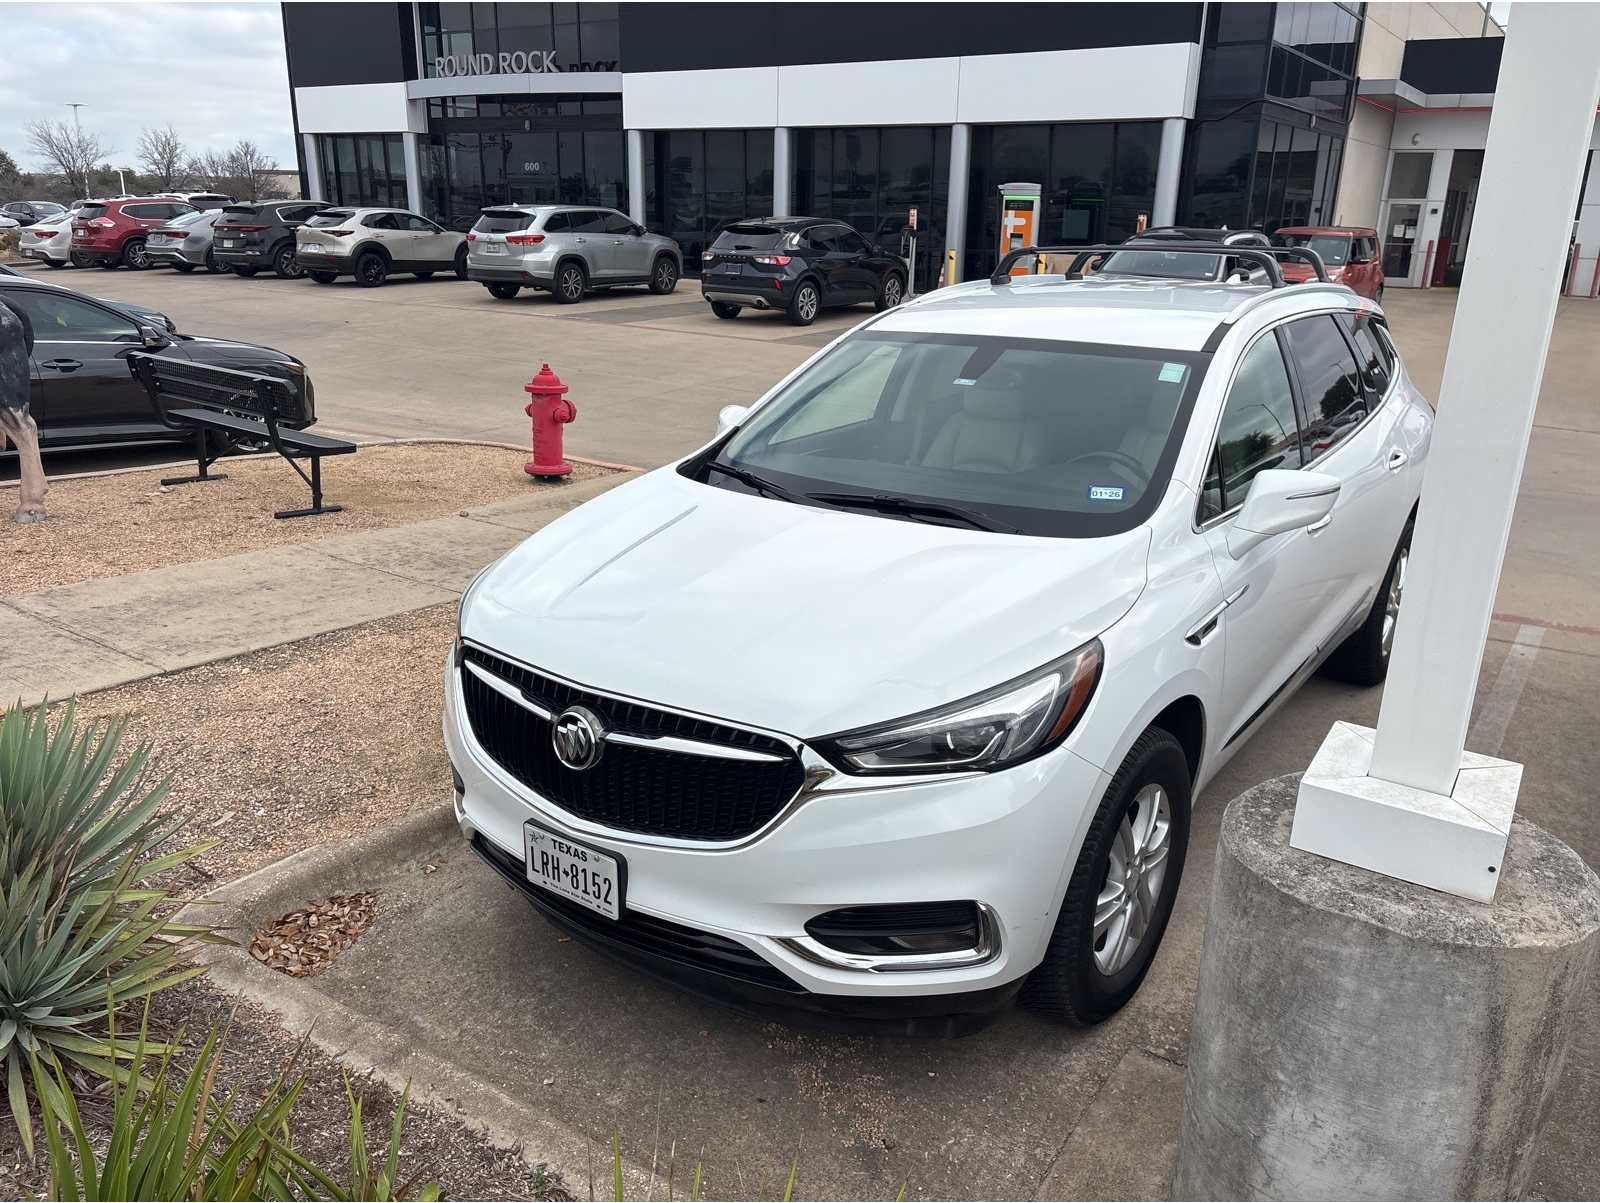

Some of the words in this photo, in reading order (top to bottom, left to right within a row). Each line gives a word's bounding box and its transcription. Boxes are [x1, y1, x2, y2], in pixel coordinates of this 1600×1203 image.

[435, 54, 494, 77] ROUND
[499, 50, 561, 74] ROCK
[524, 162, 540, 171] 600
[550, 838, 588, 862] TEXAS
